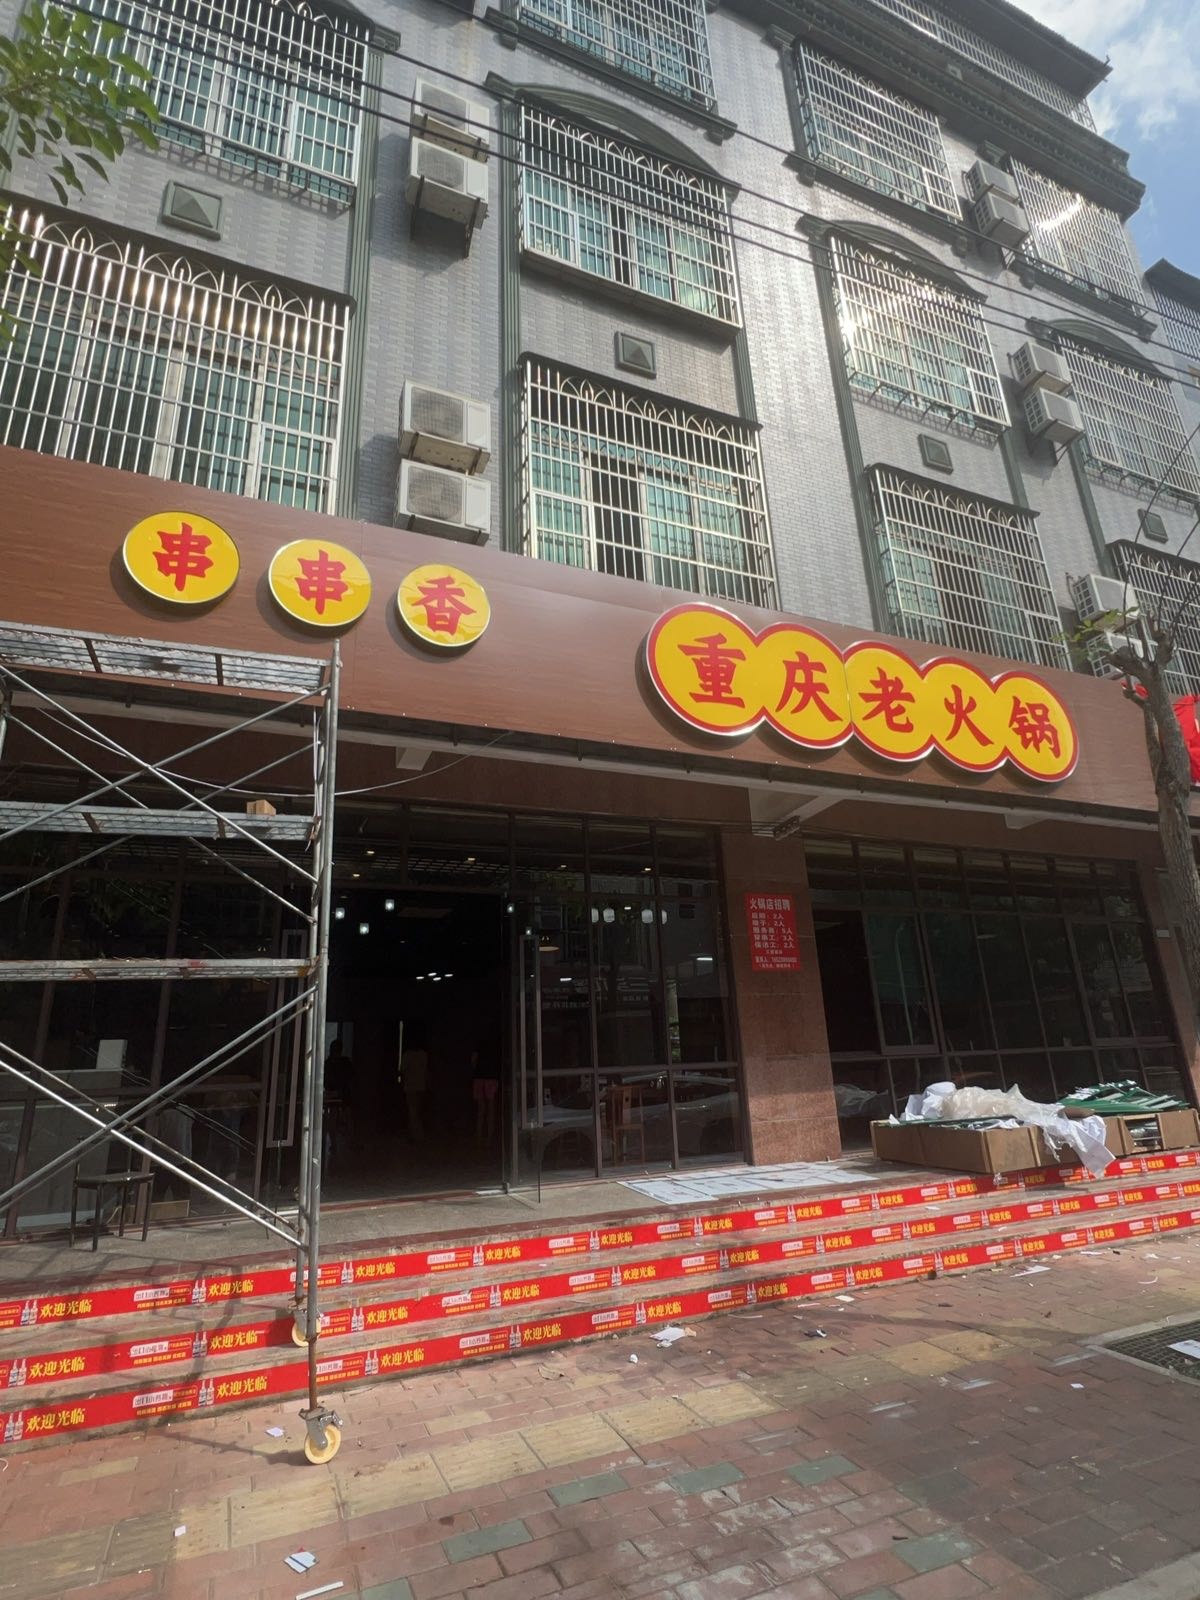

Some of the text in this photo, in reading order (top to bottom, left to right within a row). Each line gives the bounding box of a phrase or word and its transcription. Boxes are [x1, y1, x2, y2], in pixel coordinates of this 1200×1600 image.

[153, 522, 476, 635] 串串香
[677, 632, 1061, 759] 重庆老火锅
[600, 1231, 633, 1245] 欢迎光临
[485, 1246, 521, 1261] 欢迎光临
[355, 1262, 395, 1278] 欢迎光临
[623, 1266, 656, 1281] 欢迎光临
[208, 1279, 254, 1297] 欢迎光临
[502, 1284, 540, 1301] 欢迎光临
[41, 1299, 92, 1318] 欢迎光临
[366, 1306, 408, 1324] 欢迎光临
[647, 1302, 682, 1318] 欢迎光临
[210, 1330, 258, 1350] 欢迎光临
[523, 1324, 561, 1341] 欢迎光临
[30, 1356, 85, 1377] 欢迎光临
[380, 1348, 425, 1367] 欢迎光临
[217, 1375, 267, 1398] 欢迎光临
[27, 1408, 85, 1432] 欢迎光临
